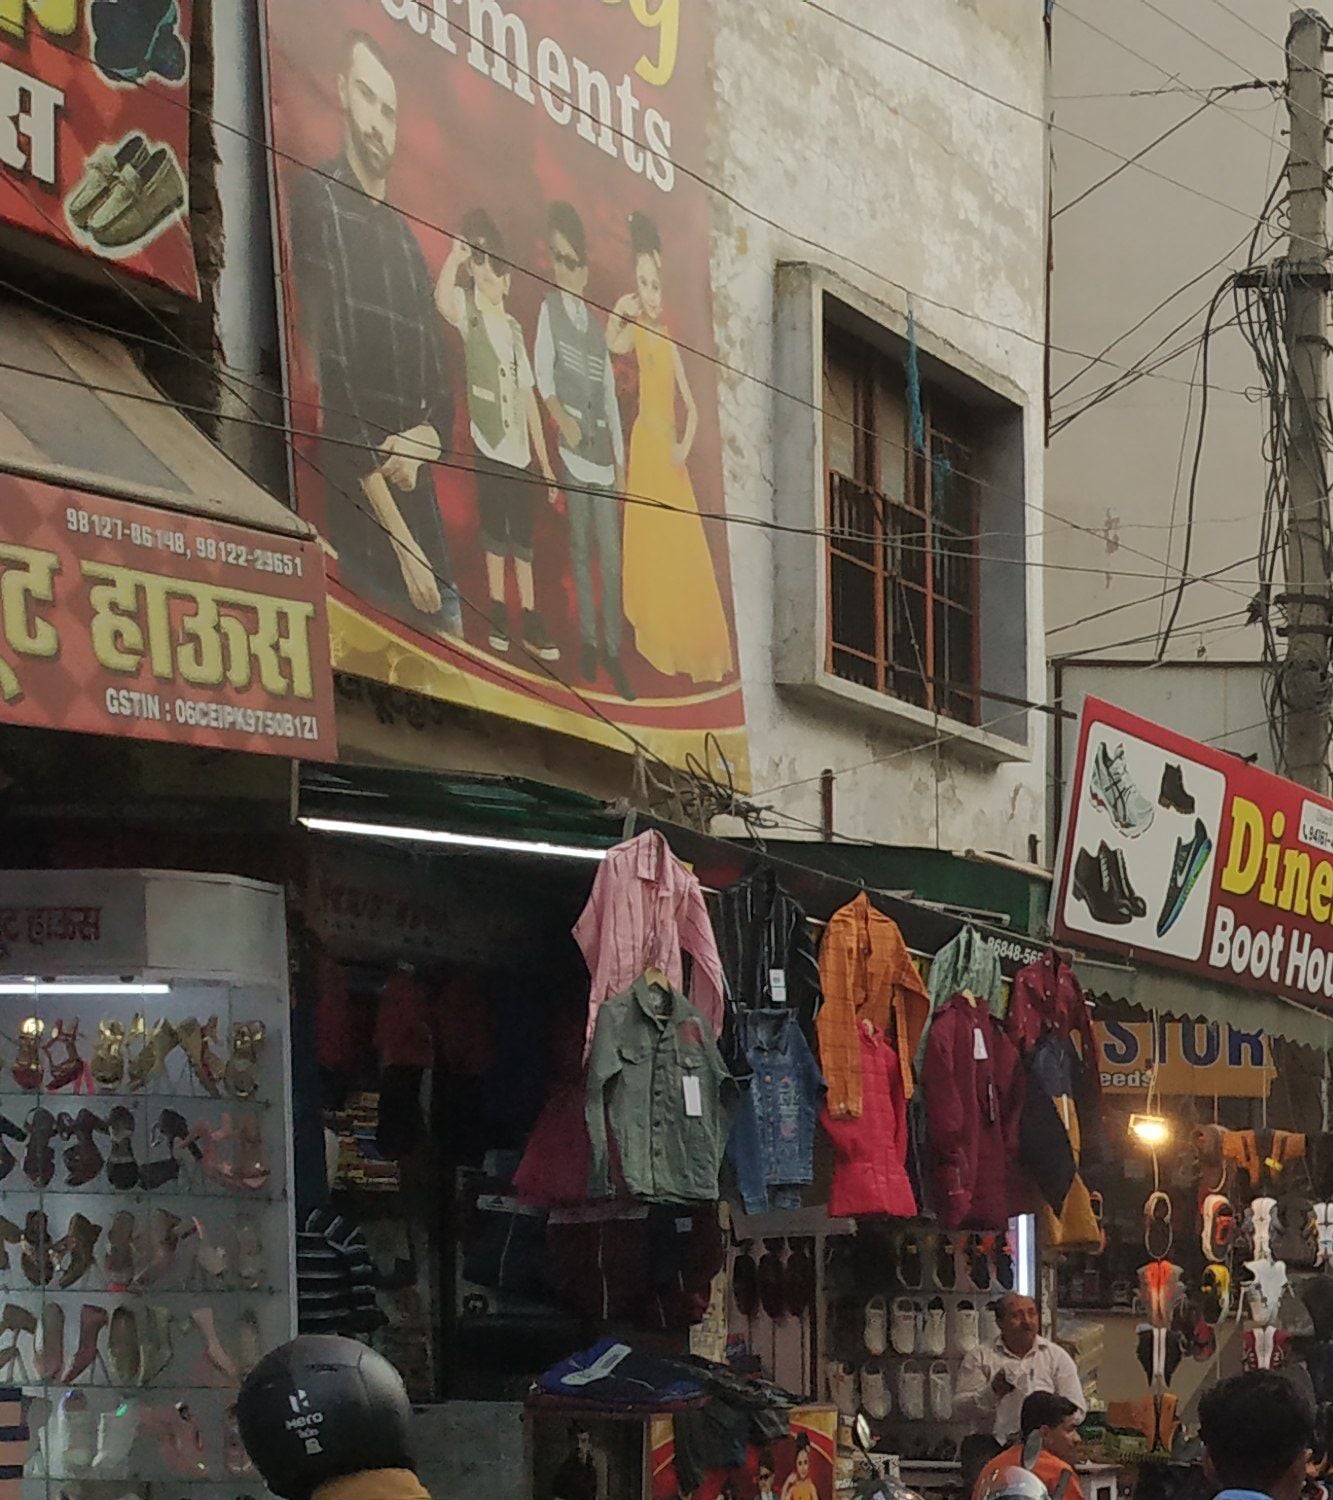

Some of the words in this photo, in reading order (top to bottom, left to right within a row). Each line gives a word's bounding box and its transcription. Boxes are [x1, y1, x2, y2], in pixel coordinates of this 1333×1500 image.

[106, 688, 160, 721] GSTIN
[1209, 905, 1284, 983] Boot
[1100, 1070, 1151, 1088] eeds
